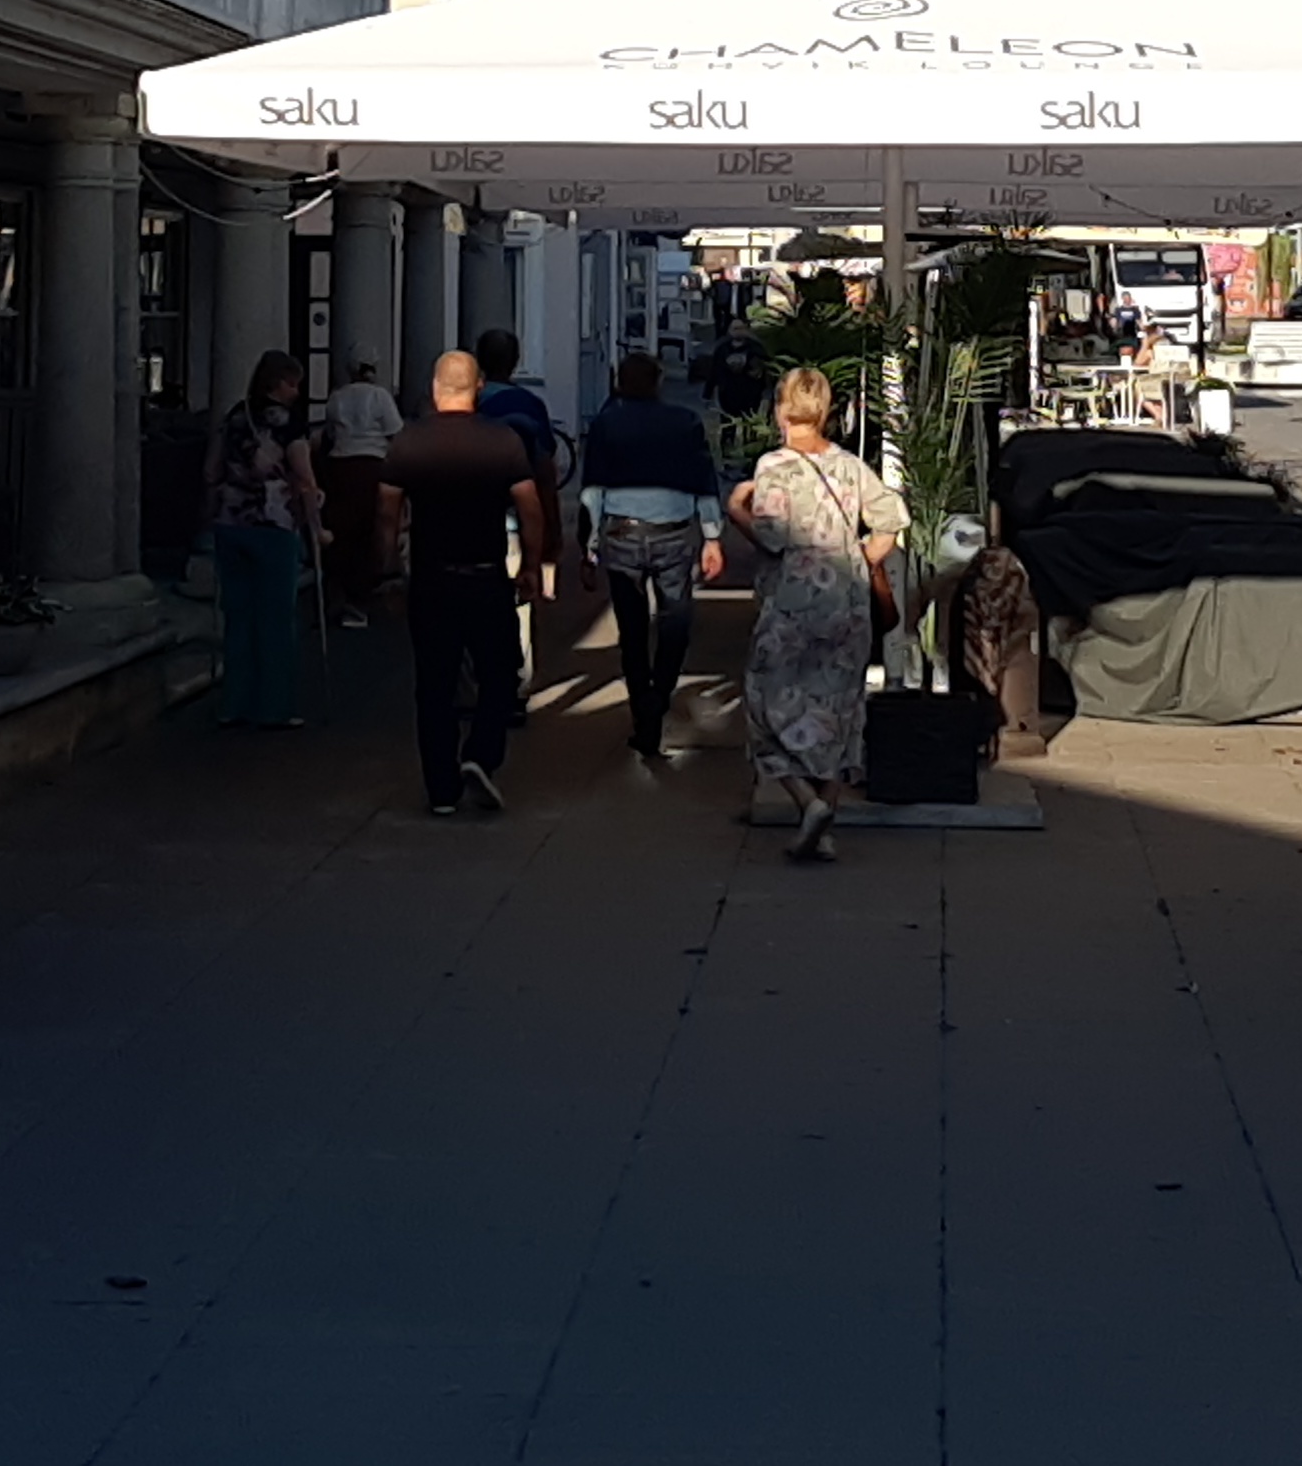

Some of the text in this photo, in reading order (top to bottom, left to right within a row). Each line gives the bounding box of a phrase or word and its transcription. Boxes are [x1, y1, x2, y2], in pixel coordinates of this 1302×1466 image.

[599, 31, 1198, 61] CHAMELEON
[921, 60, 1202, 70] LOUNGE
[259, 87, 359, 126] saku
[649, 88, 748, 130] saku
[1040, 90, 1141, 130] saku
